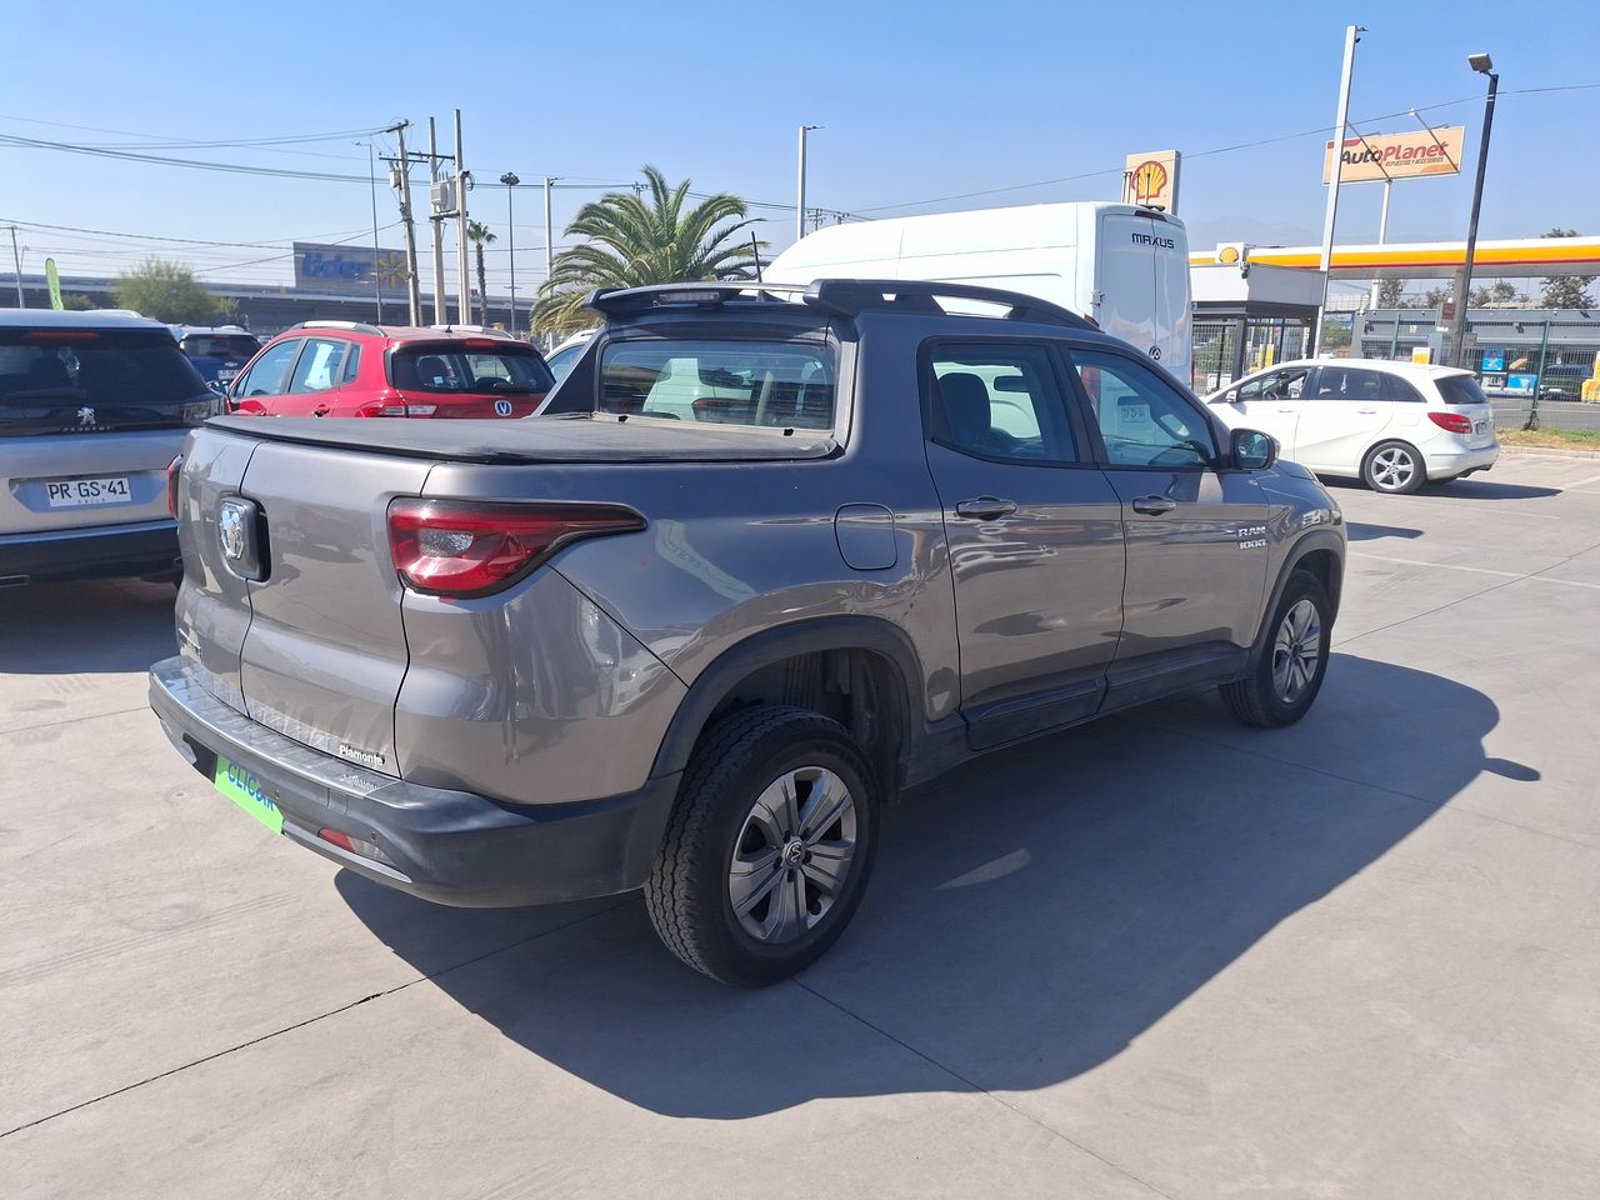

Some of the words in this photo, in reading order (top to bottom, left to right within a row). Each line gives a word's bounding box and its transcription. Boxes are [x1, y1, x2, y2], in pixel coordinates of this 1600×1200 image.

[1132, 233, 1175, 249] MAXUS
[48, 484, 72, 499] PR
[78, 481, 100, 497] GS
[108, 480, 128, 495] 41
[1238, 526, 1266, 537] RAM
